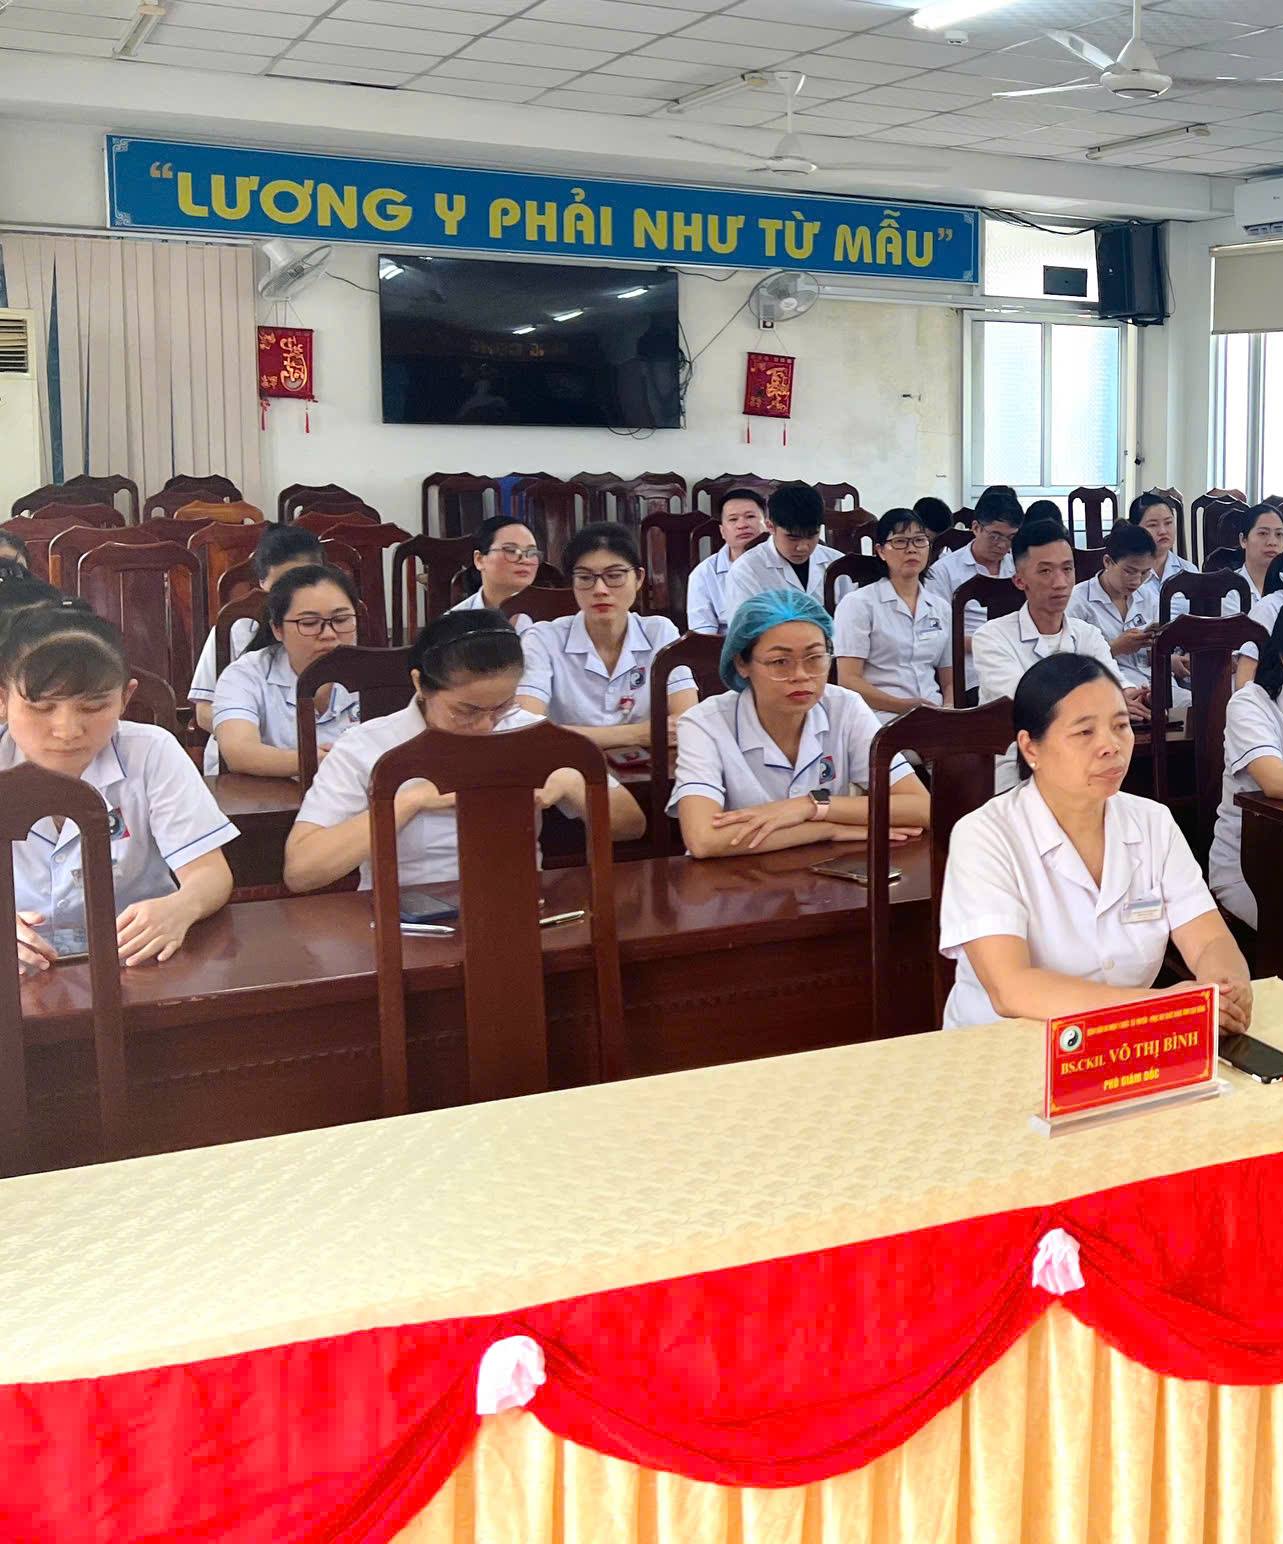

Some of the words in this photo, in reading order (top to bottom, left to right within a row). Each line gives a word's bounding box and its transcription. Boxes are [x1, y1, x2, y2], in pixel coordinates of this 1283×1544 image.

[434, 194, 466, 235] Y
[489, 187, 613, 246] PHẢI
[633, 207, 745, 255] NHƯ
[758, 210, 821, 259] TỪ
[1109, 1043, 1131, 1063] VÕ
[1133, 1039, 1160, 1058] THỊ
[1163, 1031, 1199, 1052] BÌNH
[1103, 1077, 1120, 1091] PHÓ
[1121, 1072, 1142, 1087] GIÁM
[1143, 1066, 1160, 1081] ĐỐC
